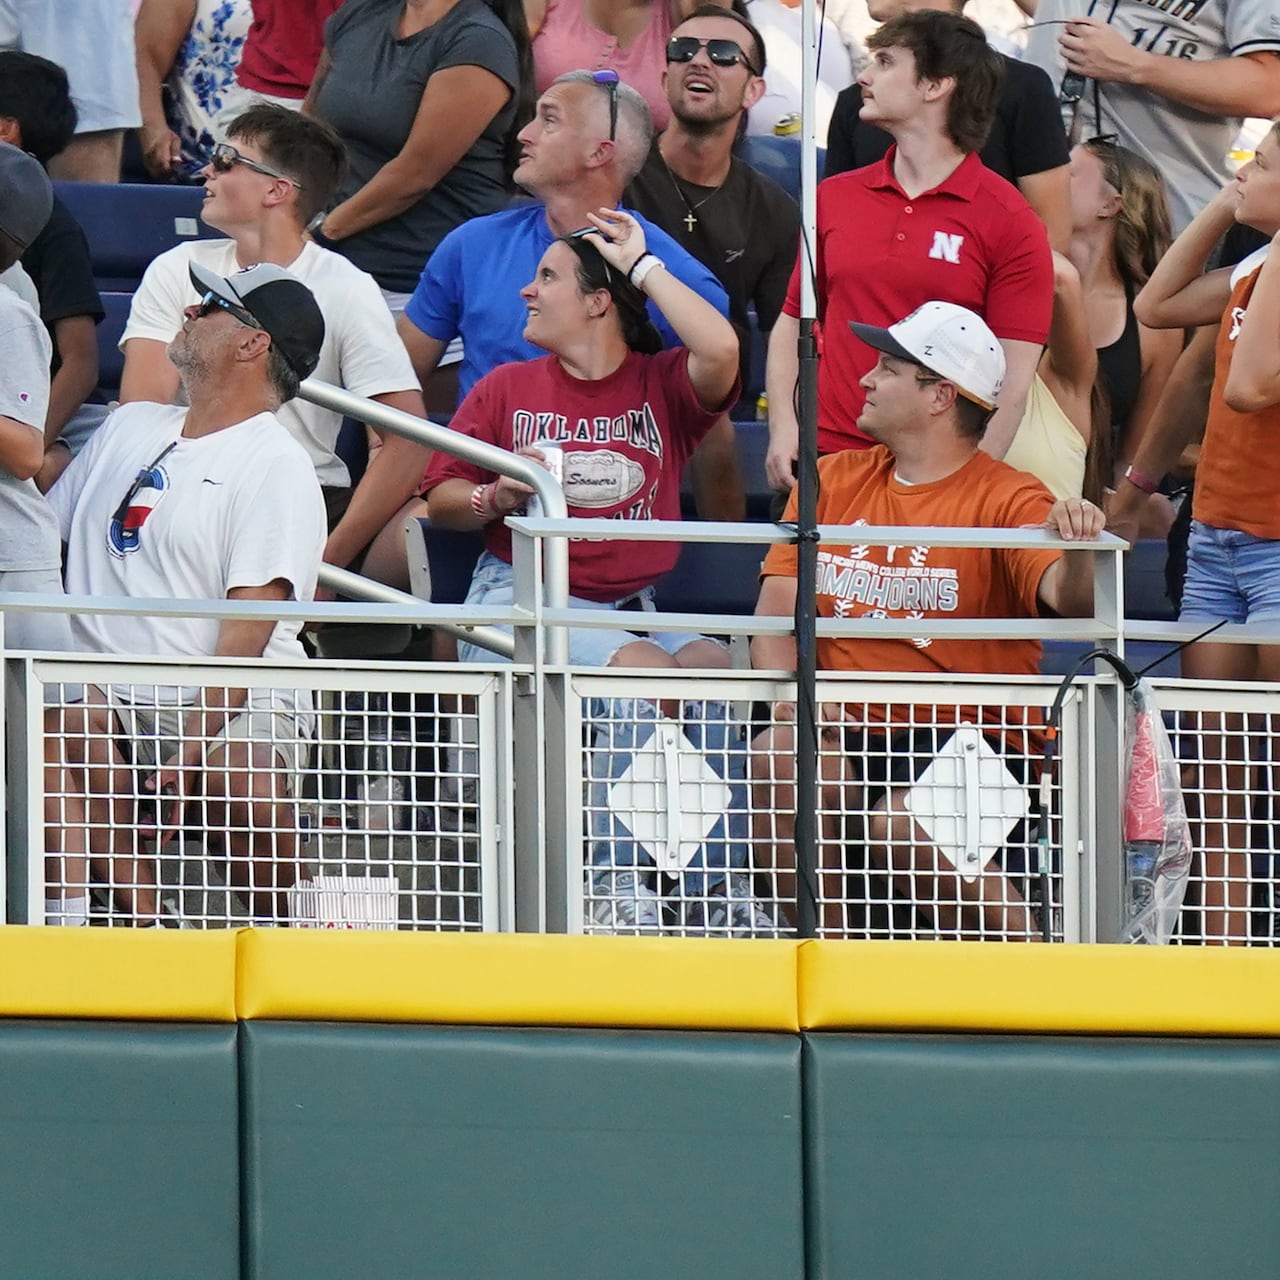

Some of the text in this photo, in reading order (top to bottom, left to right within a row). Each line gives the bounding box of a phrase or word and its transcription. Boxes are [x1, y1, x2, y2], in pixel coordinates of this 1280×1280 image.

[928, 230, 965, 265] N
[514, 401, 664, 469] OKLAHOMA
[566, 472, 618, 487] Sooners
